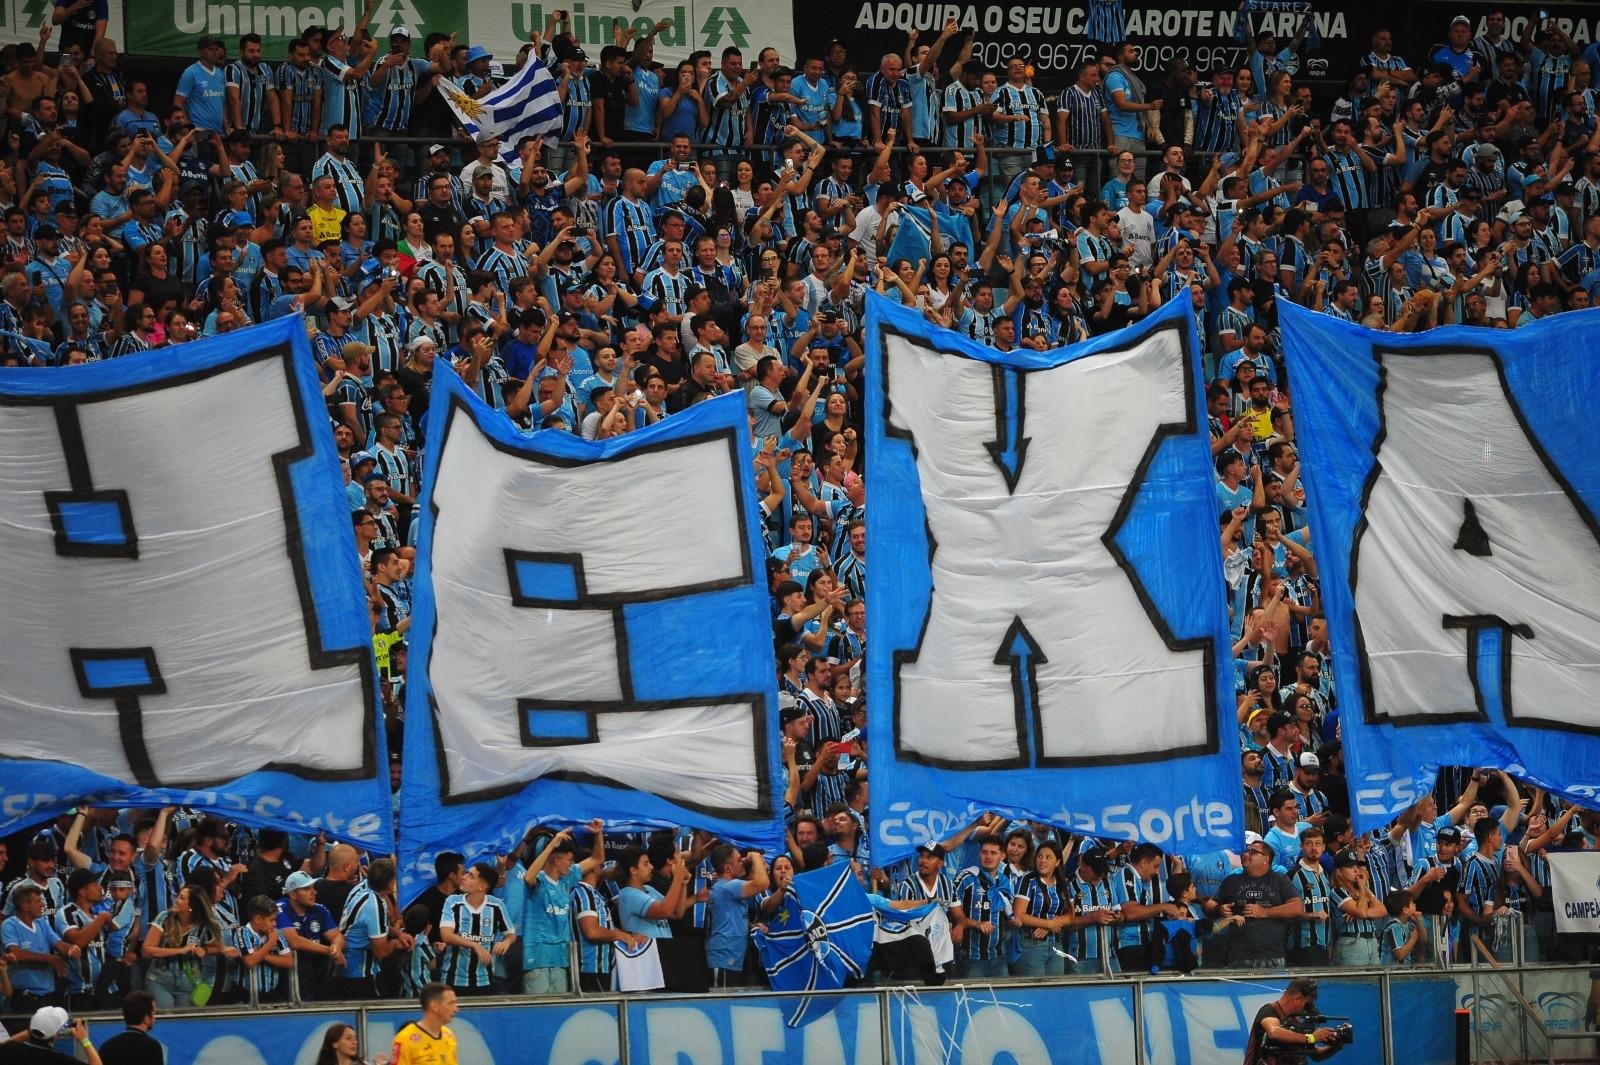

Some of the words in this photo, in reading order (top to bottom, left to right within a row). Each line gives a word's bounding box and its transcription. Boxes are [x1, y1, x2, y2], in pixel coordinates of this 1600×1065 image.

[173, 0, 355, 37] Unimed
[511, 3, 687, 47] Unimed
[984, 6, 1004, 33] O
[1007, 6, 1061, 34] SEU
[1066, 9, 1213, 37] CAROTE
[1101, 793, 1233, 845] Sorte
[461, 932, 495, 943] Banrisul
